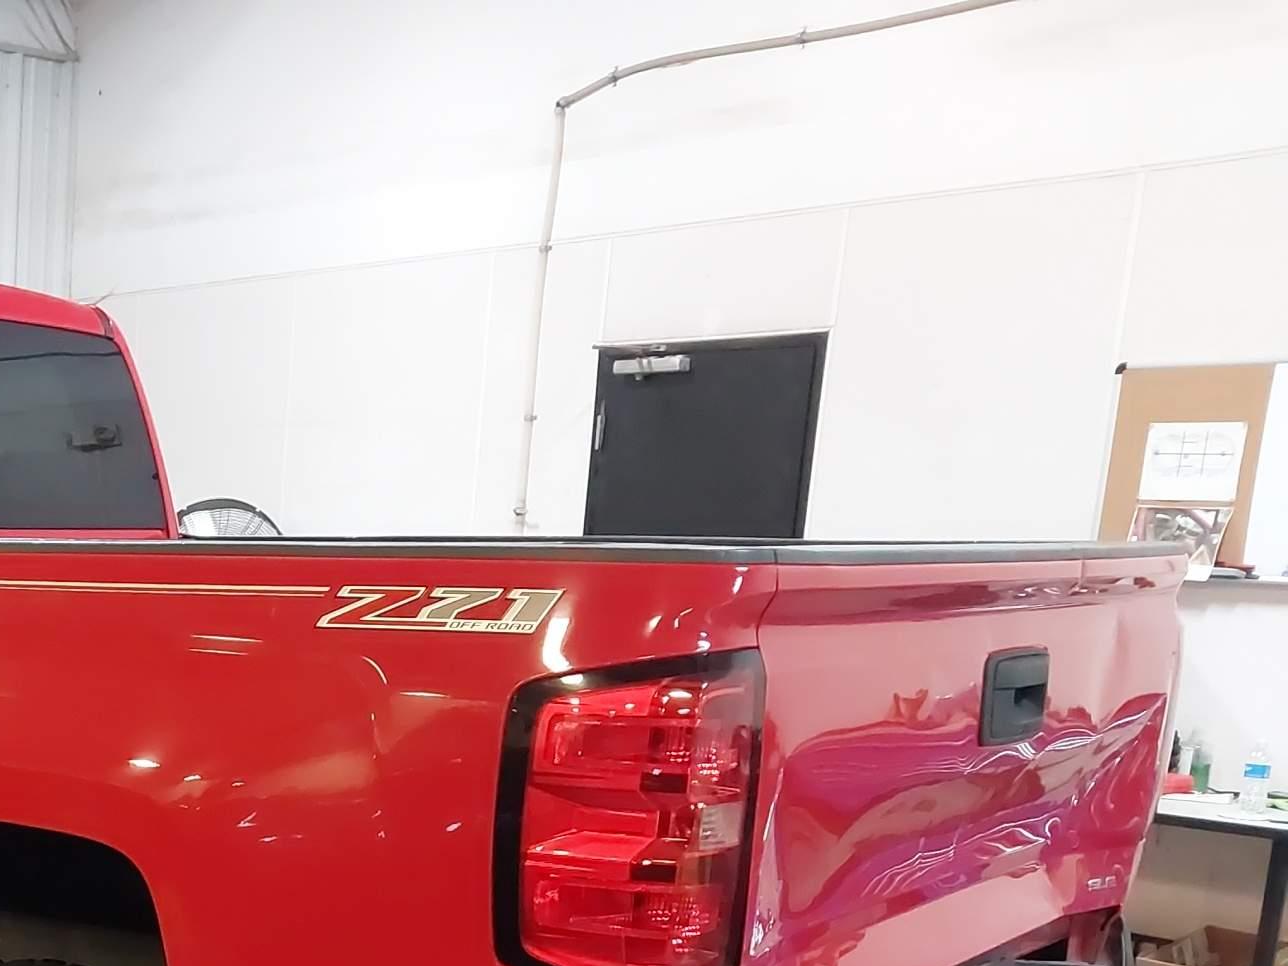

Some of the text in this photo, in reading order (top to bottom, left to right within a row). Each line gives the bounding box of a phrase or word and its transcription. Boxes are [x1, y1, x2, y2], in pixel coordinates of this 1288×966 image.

[316, 585, 566, 633] Z71
[449, 621, 535, 632] OFF ROAD
